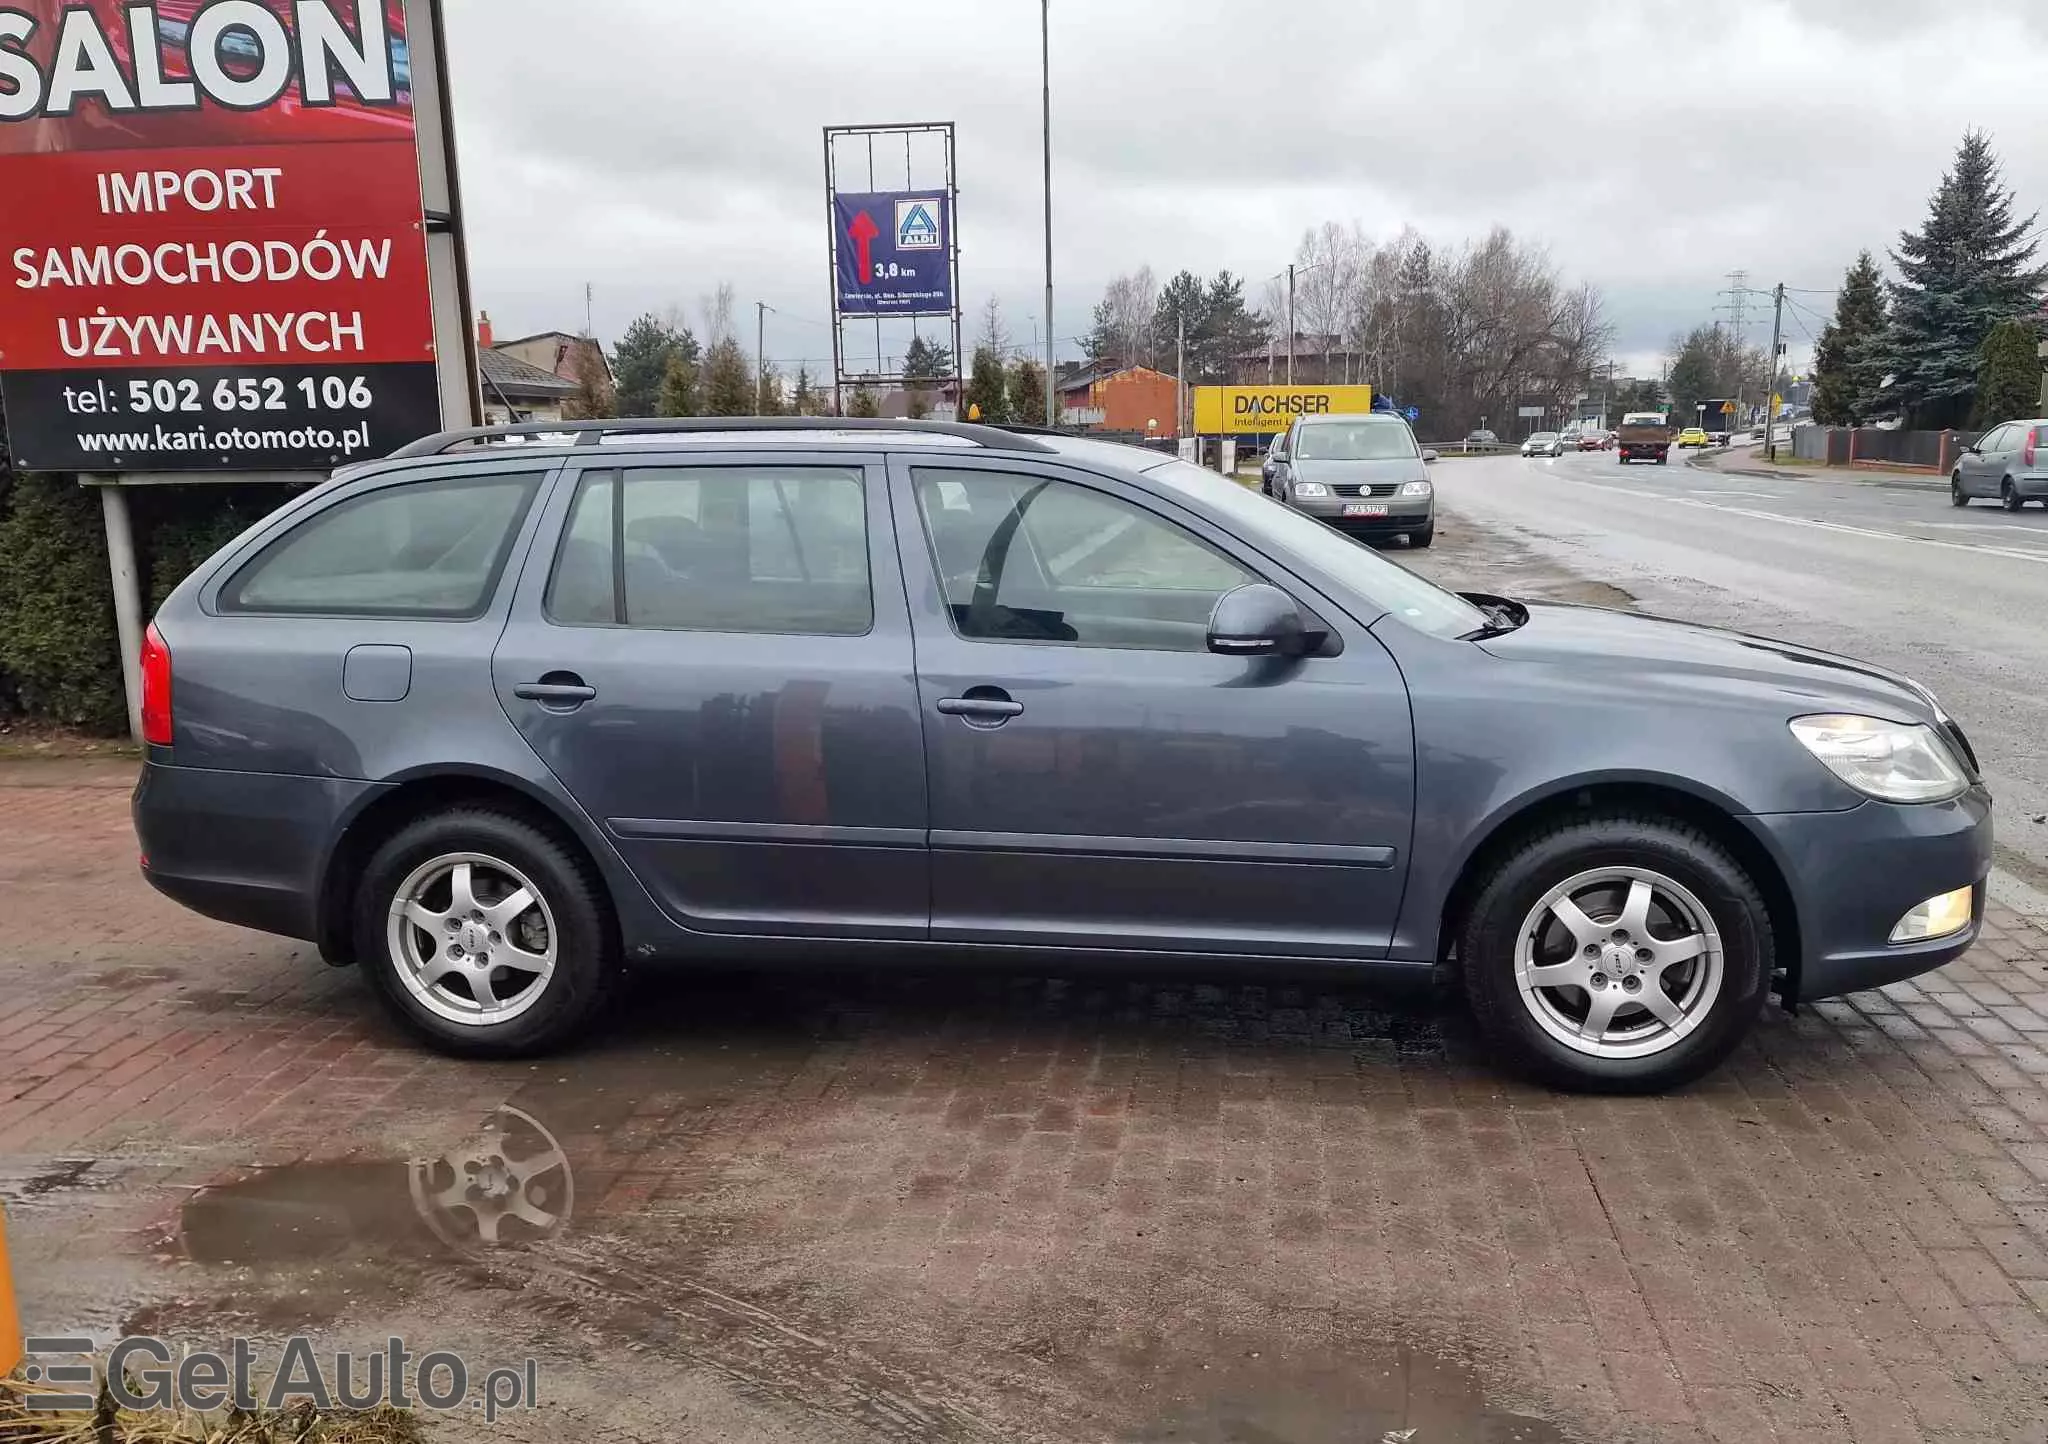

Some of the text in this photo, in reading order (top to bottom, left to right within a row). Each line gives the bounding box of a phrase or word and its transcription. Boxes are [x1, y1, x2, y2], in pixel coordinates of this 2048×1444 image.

[0, 0, 393, 118] SALON
[97, 167, 282, 213] IMPORT
[903, 234, 934, 244] ALDI
[12, 229, 392, 289] SAMOCHODÓW
[900, 267, 916, 277] km
[57, 306, 365, 357] UŻYWANYCH
[63, 375, 373, 414] tel: 502 652 106
[1234, 394, 1330, 414] DACHSER
[77, 421, 370, 454] www.kari.otomoto.pl
